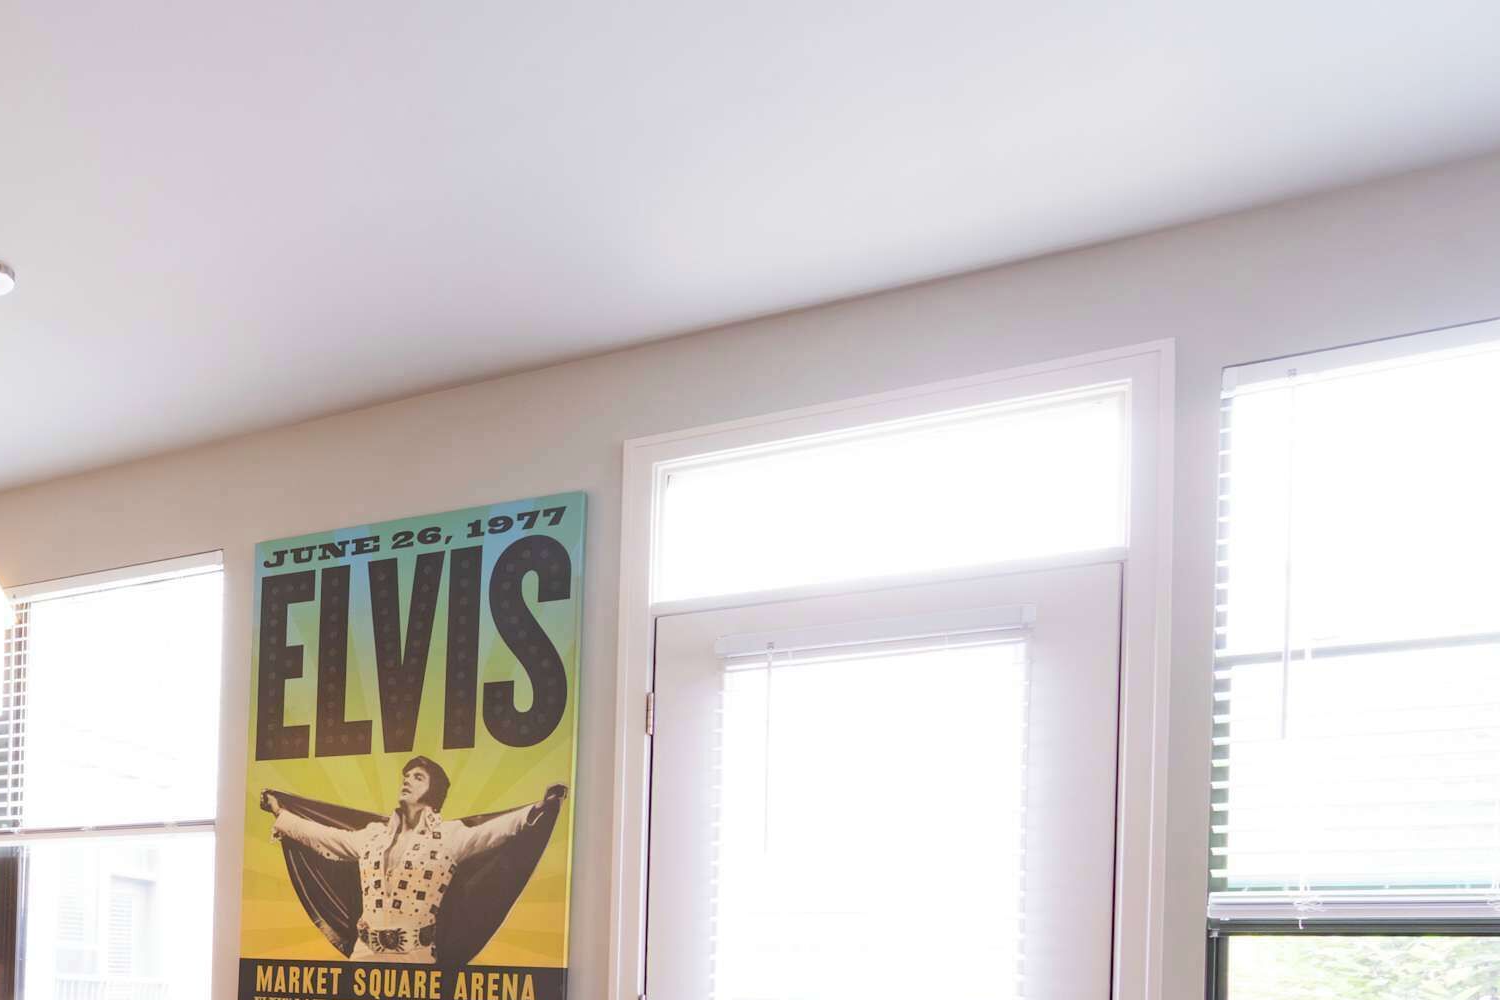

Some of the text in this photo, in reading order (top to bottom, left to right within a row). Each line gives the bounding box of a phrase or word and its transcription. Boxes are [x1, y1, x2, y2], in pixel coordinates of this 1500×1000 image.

[263, 506, 567, 568] JUNE 26, 1977
[255, 534, 572, 761] ELVIS
[255, 965, 342, 995] MARKET
[353, 968, 443, 1000] SQUARE
